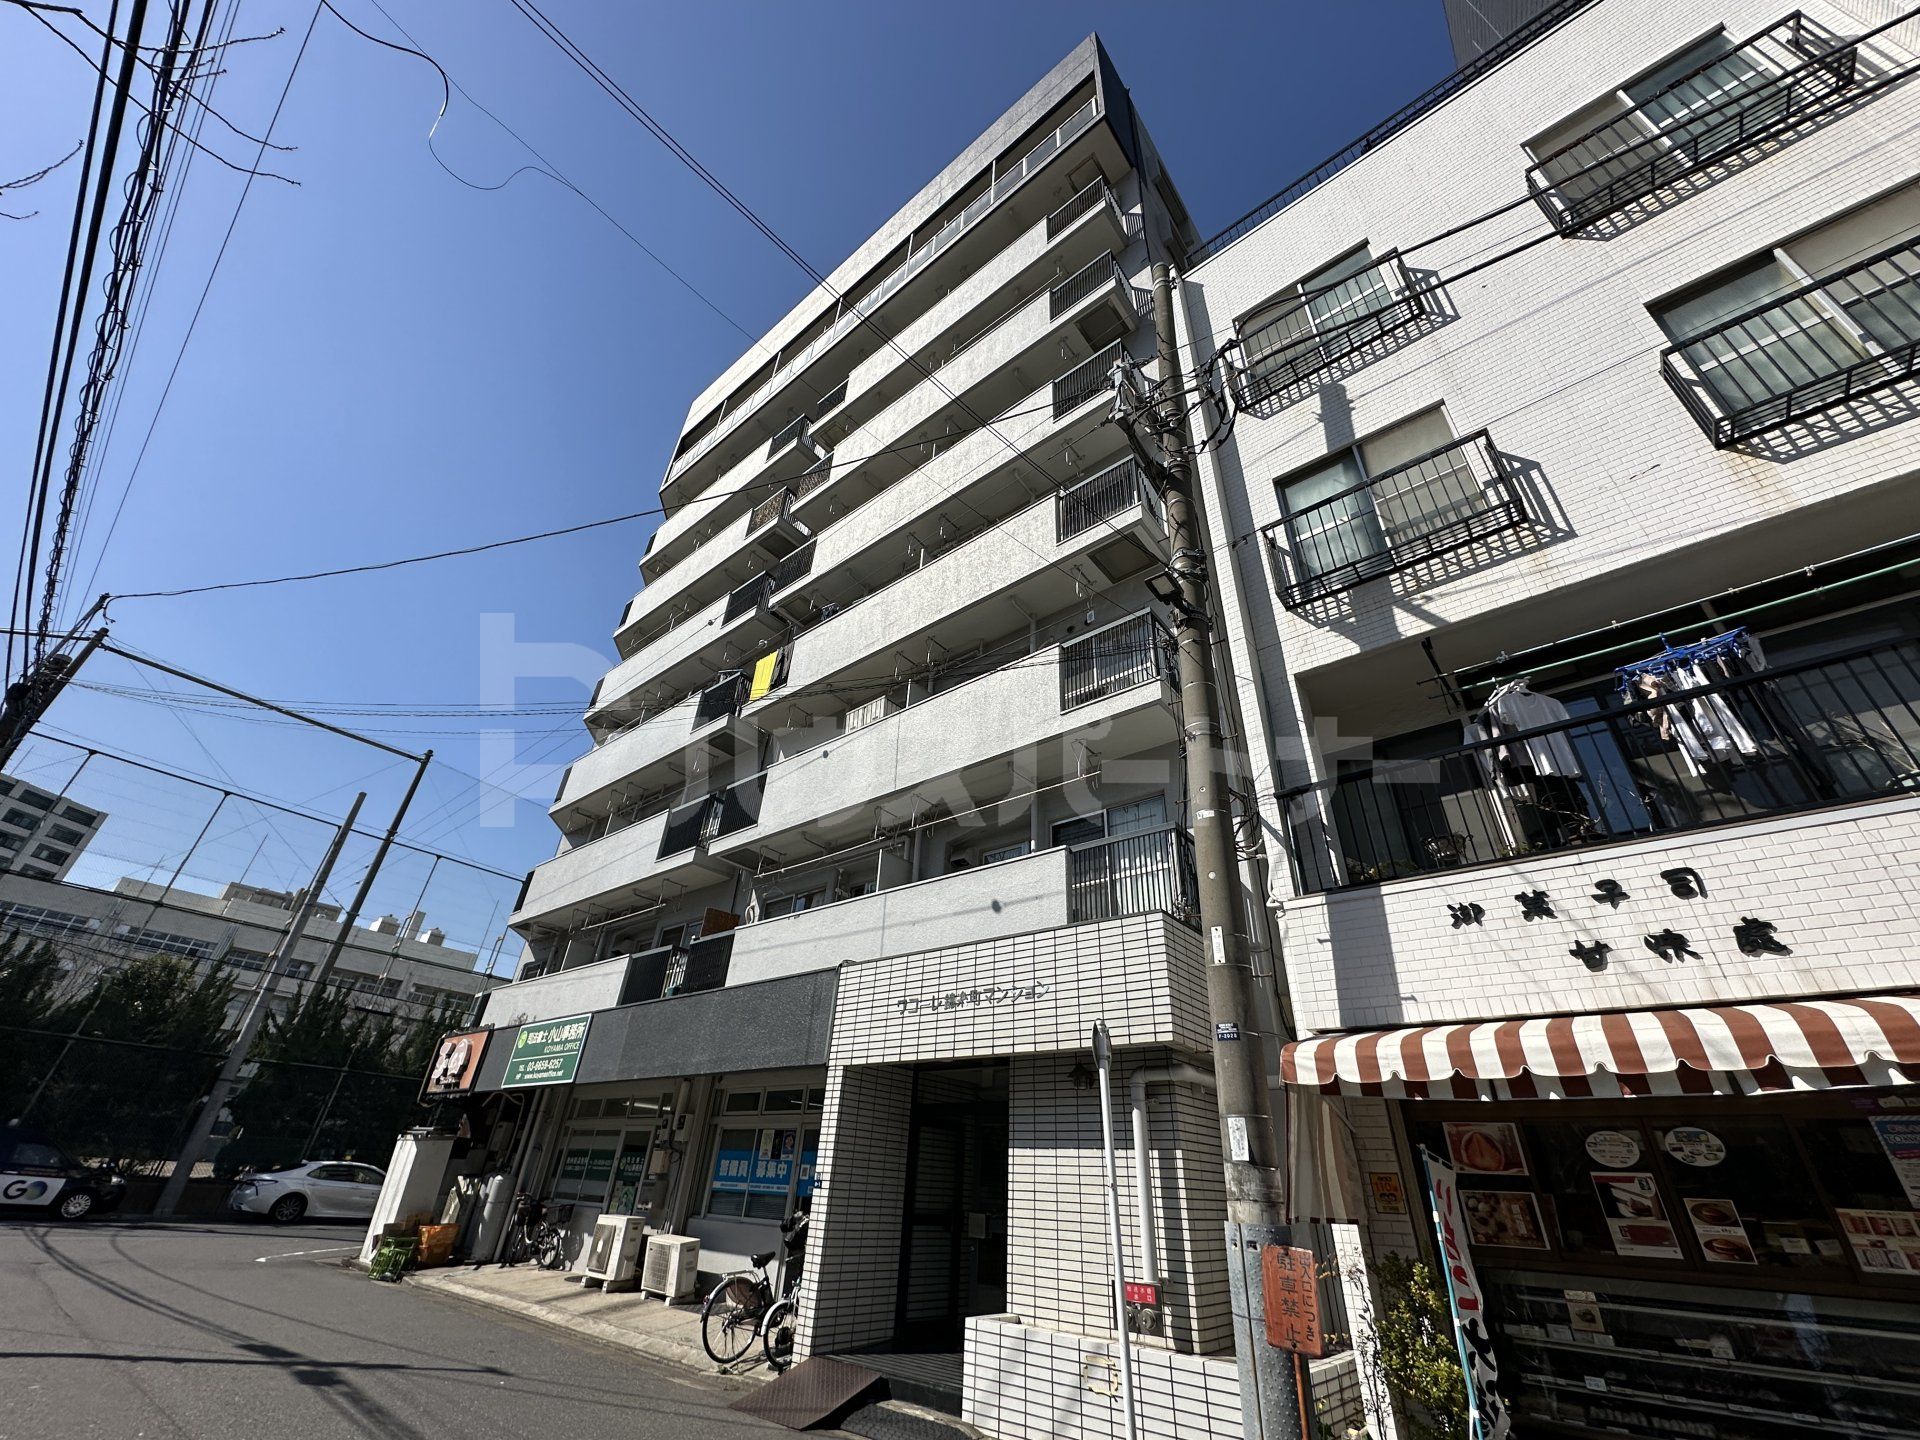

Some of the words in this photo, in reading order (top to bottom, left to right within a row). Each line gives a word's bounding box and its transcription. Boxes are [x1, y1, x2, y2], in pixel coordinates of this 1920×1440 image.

[1446, 866, 1709, 930] 御菓子司
[897, 981, 1050, 1015] ワコーレ錦糸町マンション
[544, 1045, 563, 1053] KOYAMA
[564, 1042, 580, 1051] OFFICE
[549, 1022, 586, 1042] 小山事務所
[756, 1161, 788, 1179] 募集中
[1276, 1252, 1301, 1344] 駐車禁止
[1298, 1252, 1316, 1342] 出入口につき
